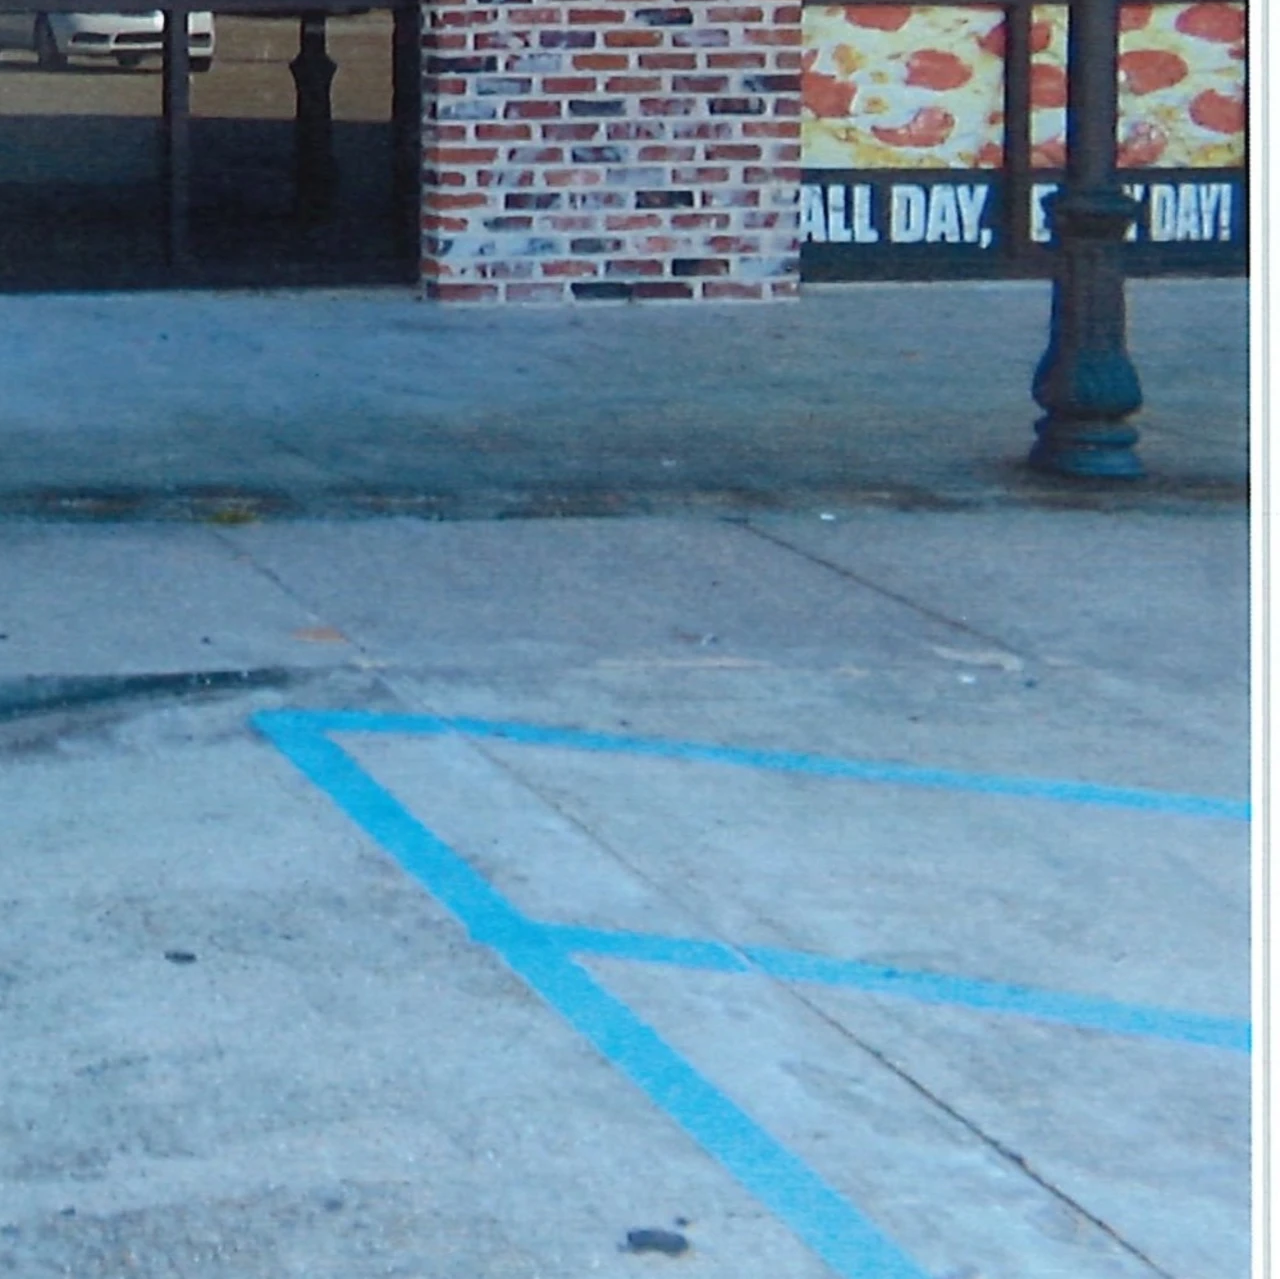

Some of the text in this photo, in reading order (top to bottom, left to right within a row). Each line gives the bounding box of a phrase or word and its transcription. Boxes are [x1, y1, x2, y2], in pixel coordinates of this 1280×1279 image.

[800, 184, 878, 244] ALL
[890, 184, 992, 249] DAY,
[1149, 183, 1233, 242] DAY!
